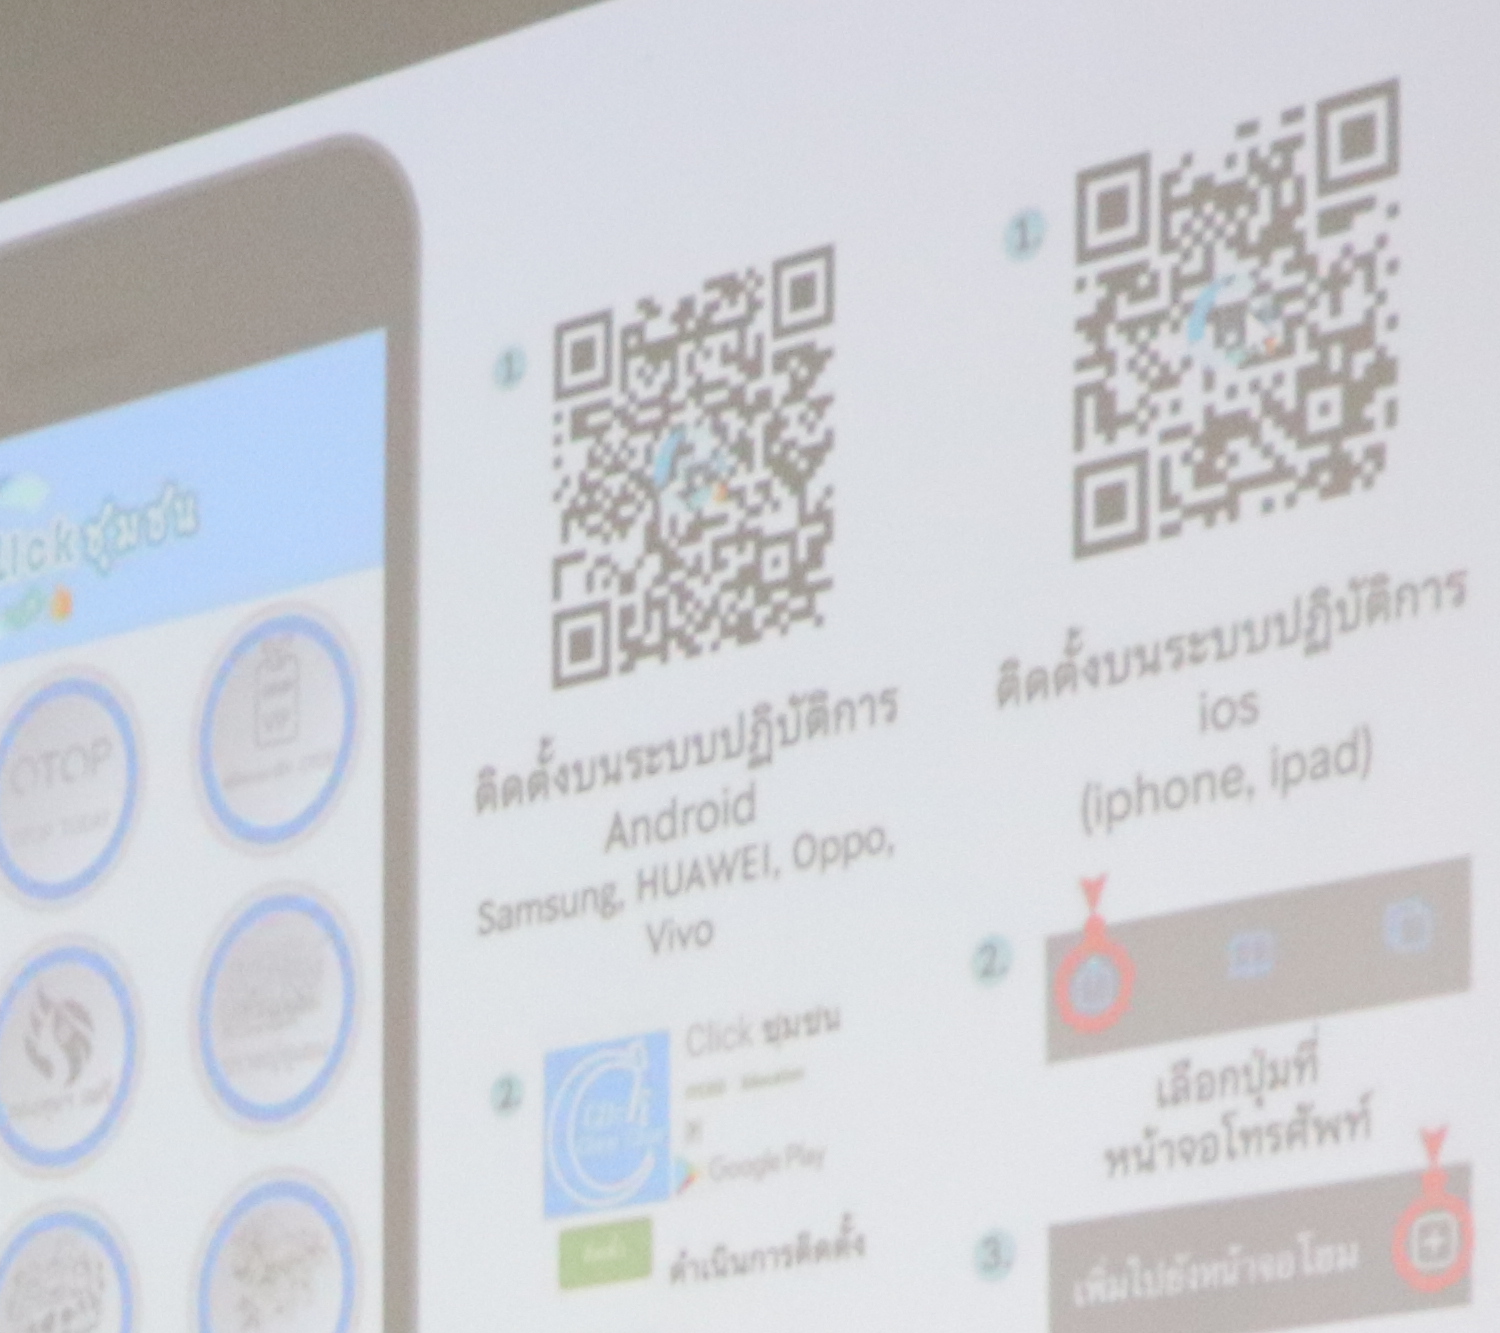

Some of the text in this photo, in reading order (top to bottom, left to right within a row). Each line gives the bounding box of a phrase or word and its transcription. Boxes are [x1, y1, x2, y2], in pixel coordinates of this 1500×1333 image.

[996, 570, 1468, 709] ติดตั้งบนระบบปฏิบัติการ
[10, 736, 112, 797] OTOP
[475, 687, 898, 815] ติดตั้งบนระบบปฏิบัติการ
[1269, 722, 1373, 798] ipad)
[605, 783, 758, 853] Android
[477, 824, 895, 936] Samsung, HUAWEI, Oppo,
[647, 918, 714, 954] Vivo
[686, 1013, 754, 1058] Click
[1156, 1023, 1320, 1110] เลือกปุ่มที่
[785, 1140, 826, 1171] Play
[1104, 1090, 1373, 1179] หน้าจอโทรศัพท์
